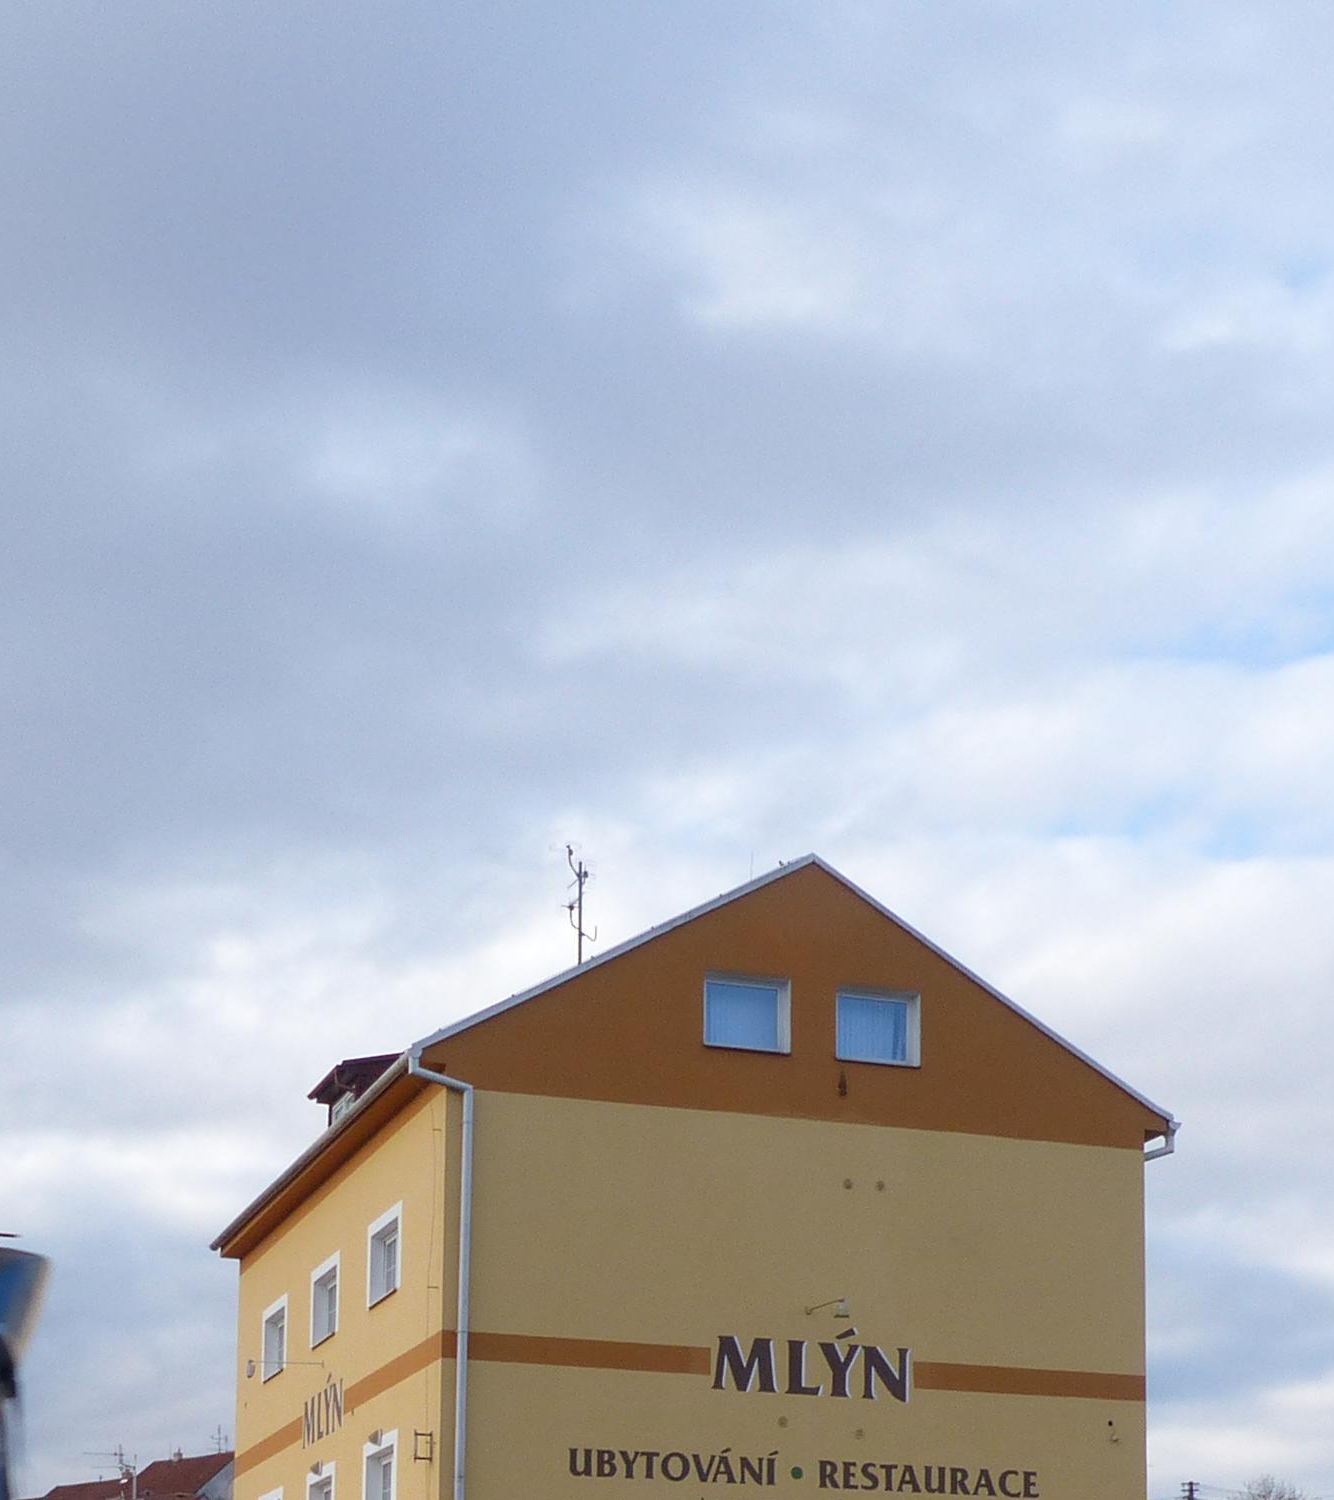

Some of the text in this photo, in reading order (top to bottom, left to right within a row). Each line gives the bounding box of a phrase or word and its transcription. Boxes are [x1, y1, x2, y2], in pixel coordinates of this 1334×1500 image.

[712, 1326, 913, 1403] MLÝN
[302, 1372, 344, 1450] MLÝN
[568, 1447, 1040, 1499] UBYTOVÁNÍ RESTAURACE
